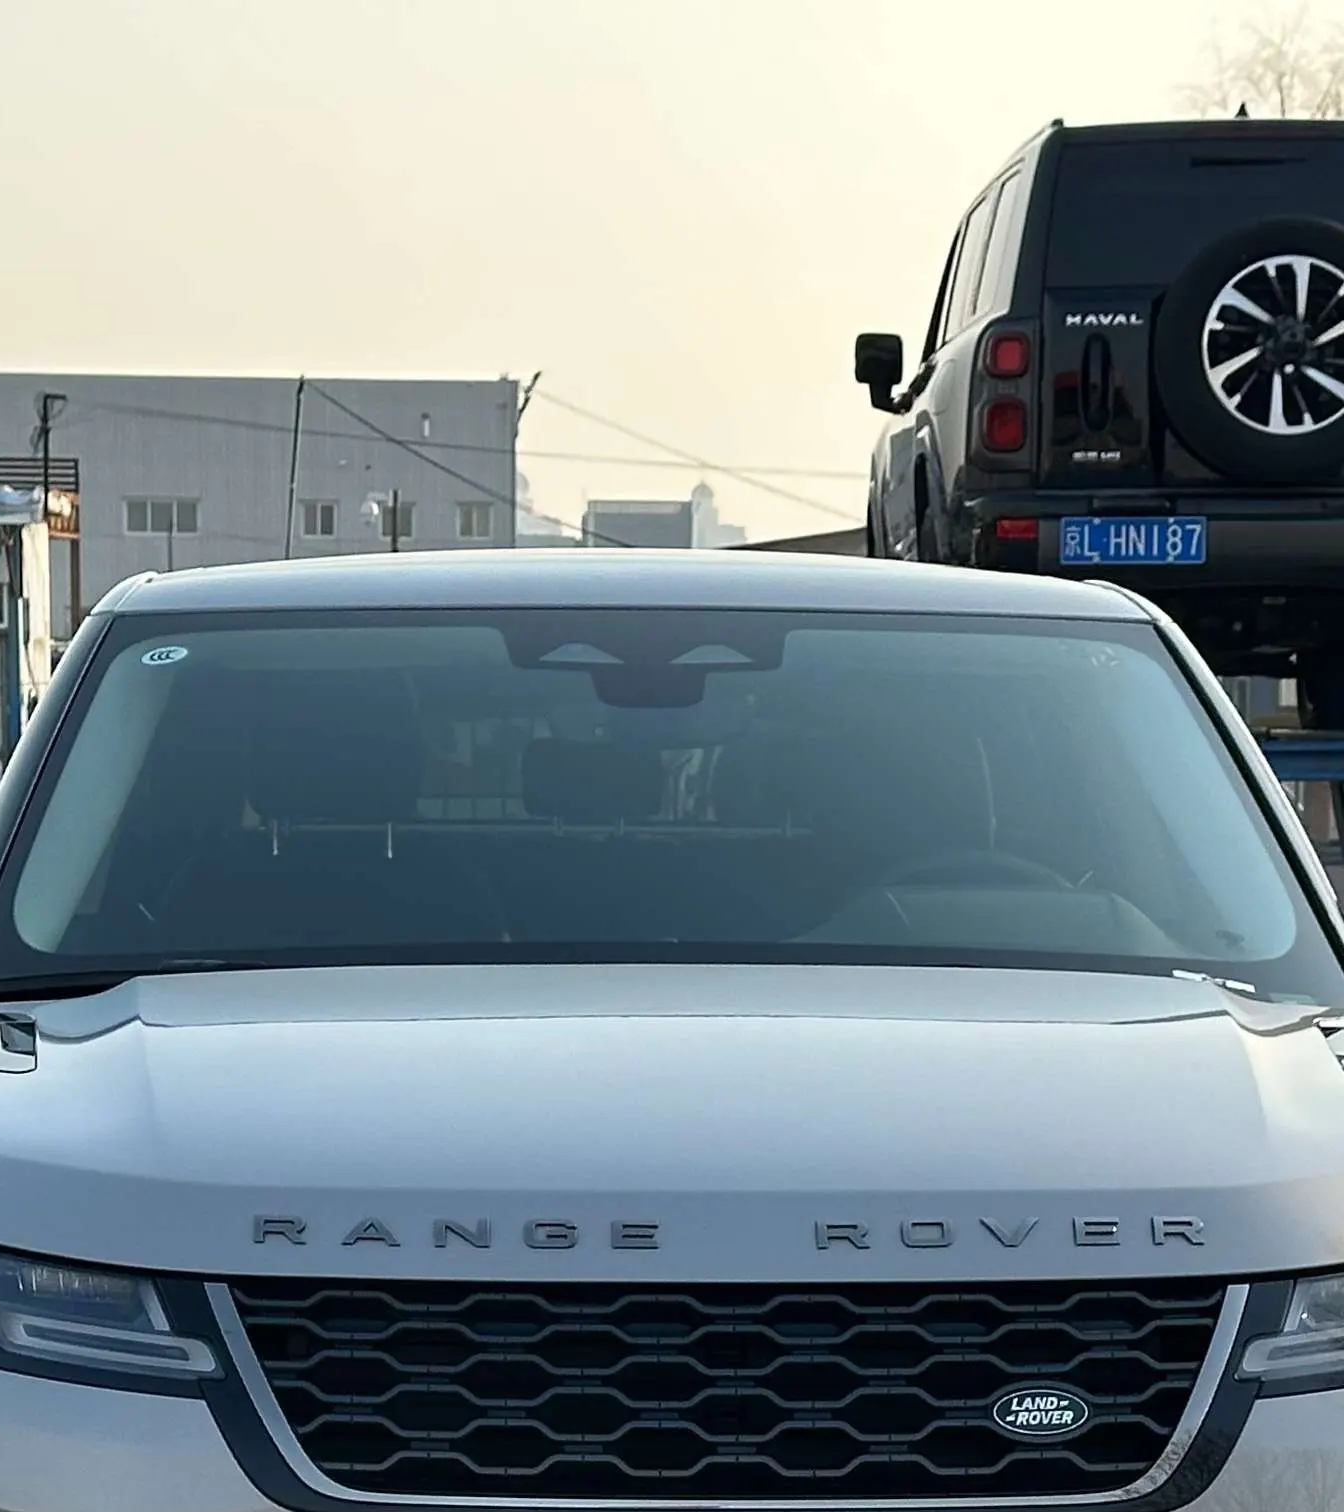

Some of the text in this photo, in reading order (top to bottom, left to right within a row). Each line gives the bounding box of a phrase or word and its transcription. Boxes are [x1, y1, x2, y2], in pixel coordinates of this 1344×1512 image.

[1065, 313, 1144, 327] HAVAL
[253, 1213, 1206, 1250] RANGE ROVER
[1011, 1396, 1059, 1411] LAND
[1015, 1410, 1074, 1426] ROVER
